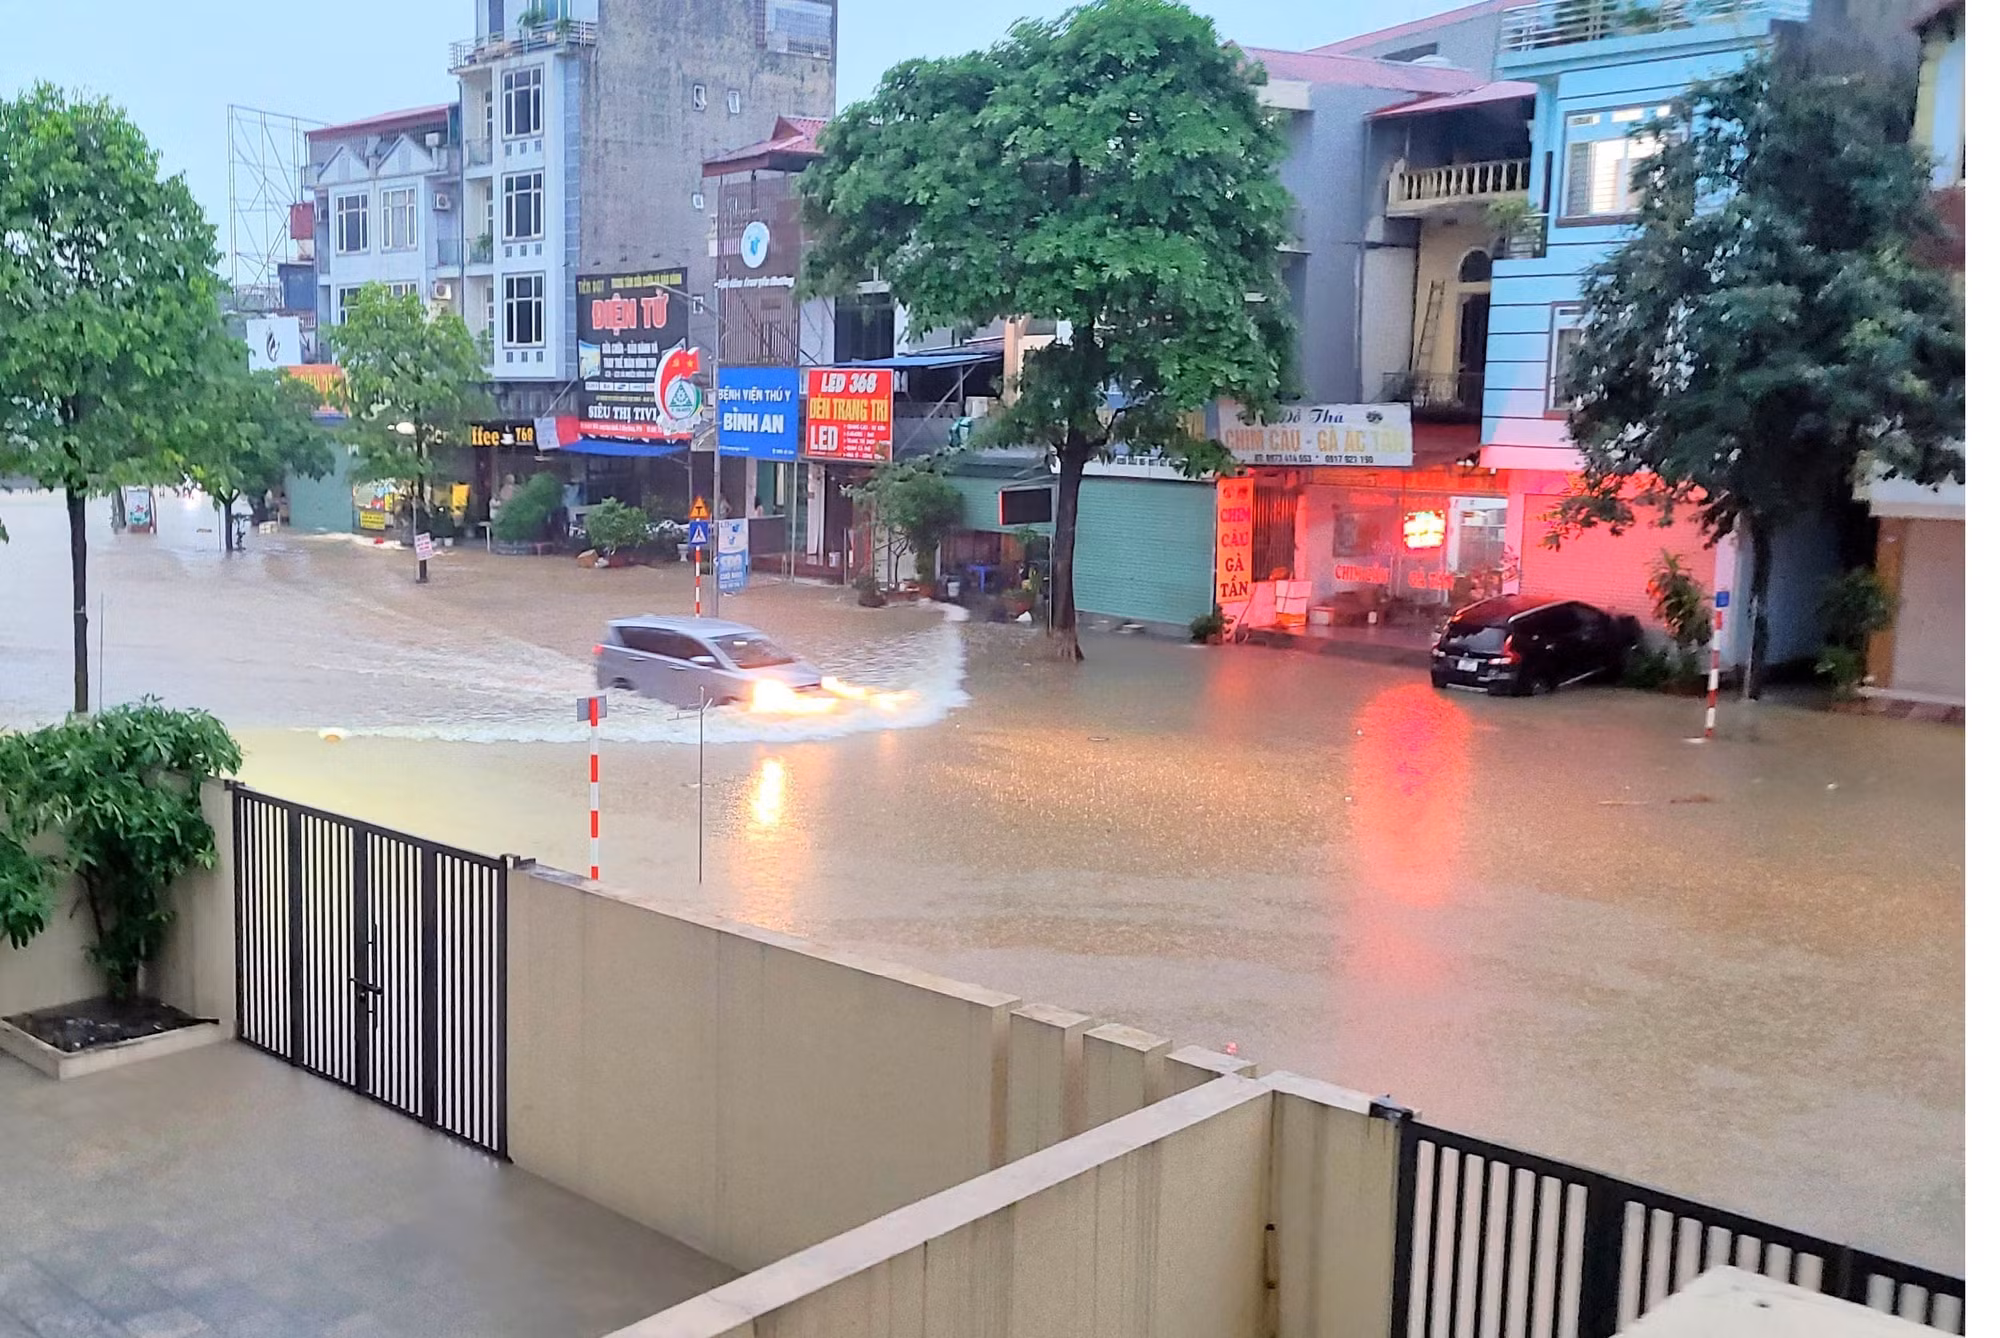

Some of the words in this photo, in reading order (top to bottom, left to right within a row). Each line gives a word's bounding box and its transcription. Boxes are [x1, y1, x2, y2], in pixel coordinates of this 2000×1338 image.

[718, 385, 741, 405] BỆNH
[742, 385, 763, 405] VIỆN
[764, 385, 783, 403] THÚ
[784, 389, 792, 403] Y
[820, 372, 847, 394] LED
[848, 372, 878, 395] 368
[588, 401, 611, 419] SIÊU
[612, 405, 631, 424] THỊ
[633, 406, 657, 421] TIVI
[723, 406, 759, 433] BÌNH
[759, 413, 784, 434] AN
[832, 397, 869, 422] TRANG
[810, 425, 838, 452] LED
[1225, 552, 1245, 573] GÀ
